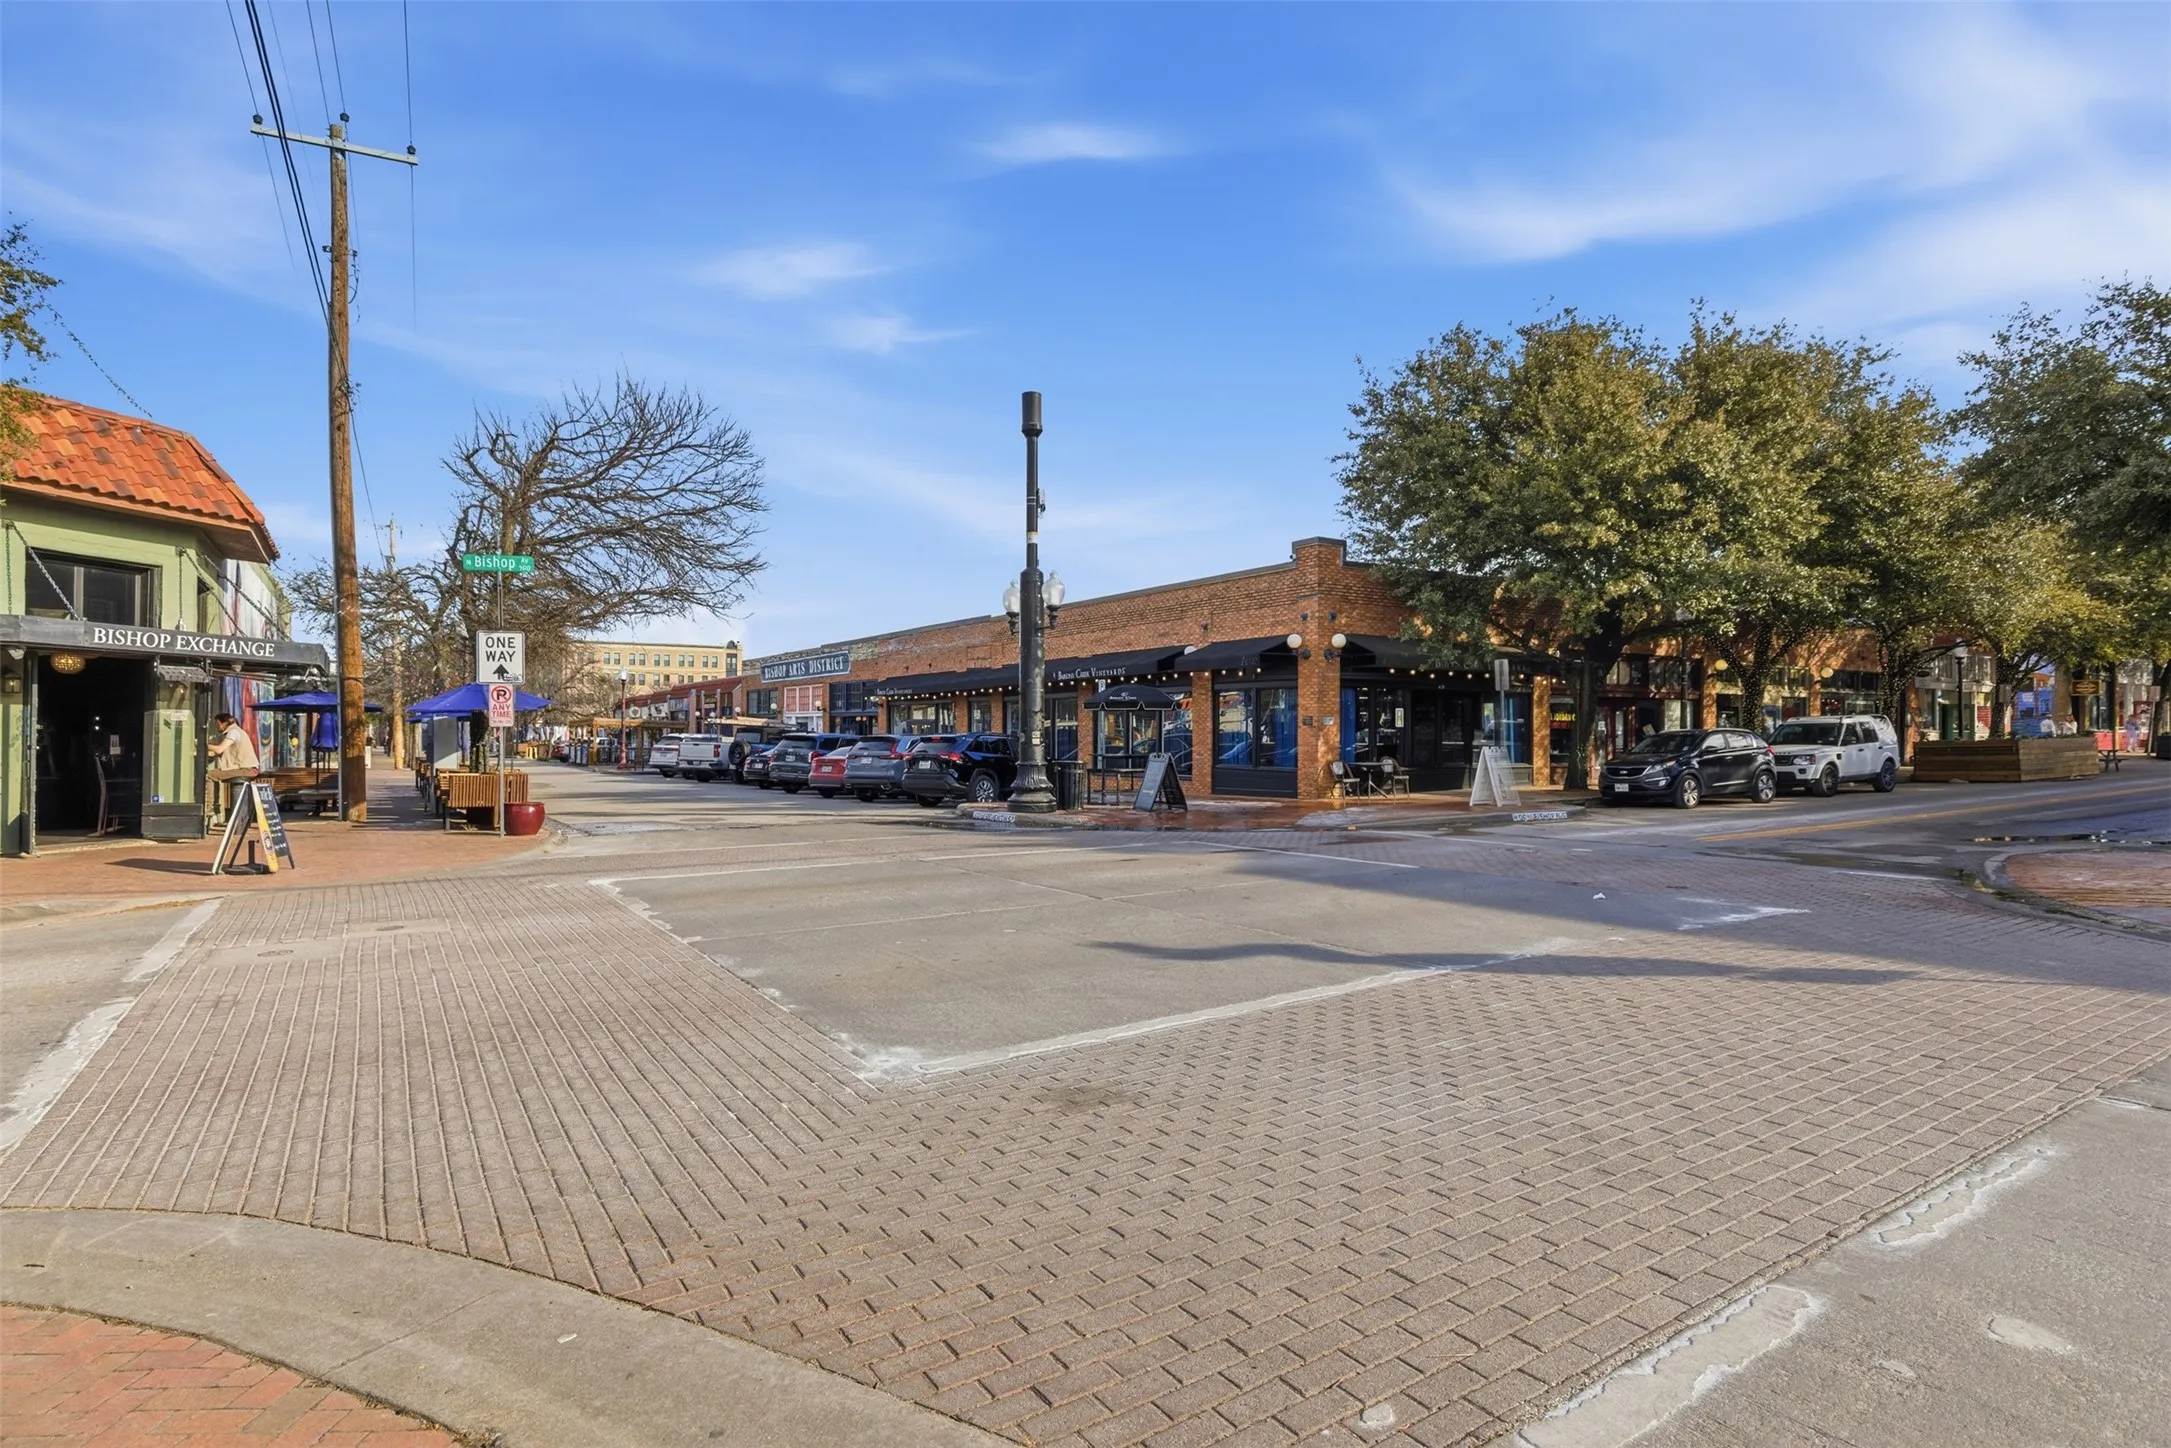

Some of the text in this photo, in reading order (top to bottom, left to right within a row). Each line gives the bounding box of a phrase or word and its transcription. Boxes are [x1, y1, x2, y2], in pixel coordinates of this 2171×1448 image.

[474, 555, 516, 571] Bishop
[93, 627, 275, 657] BISHOP EXCHANGE
[485, 636, 516, 649] ONE
[485, 650, 516, 662] WAY
[764, 656, 844, 679] BISHOP ARTS DISTRICT
[491, 703, 511, 711] ANY
[491, 710, 511, 718] TIME
